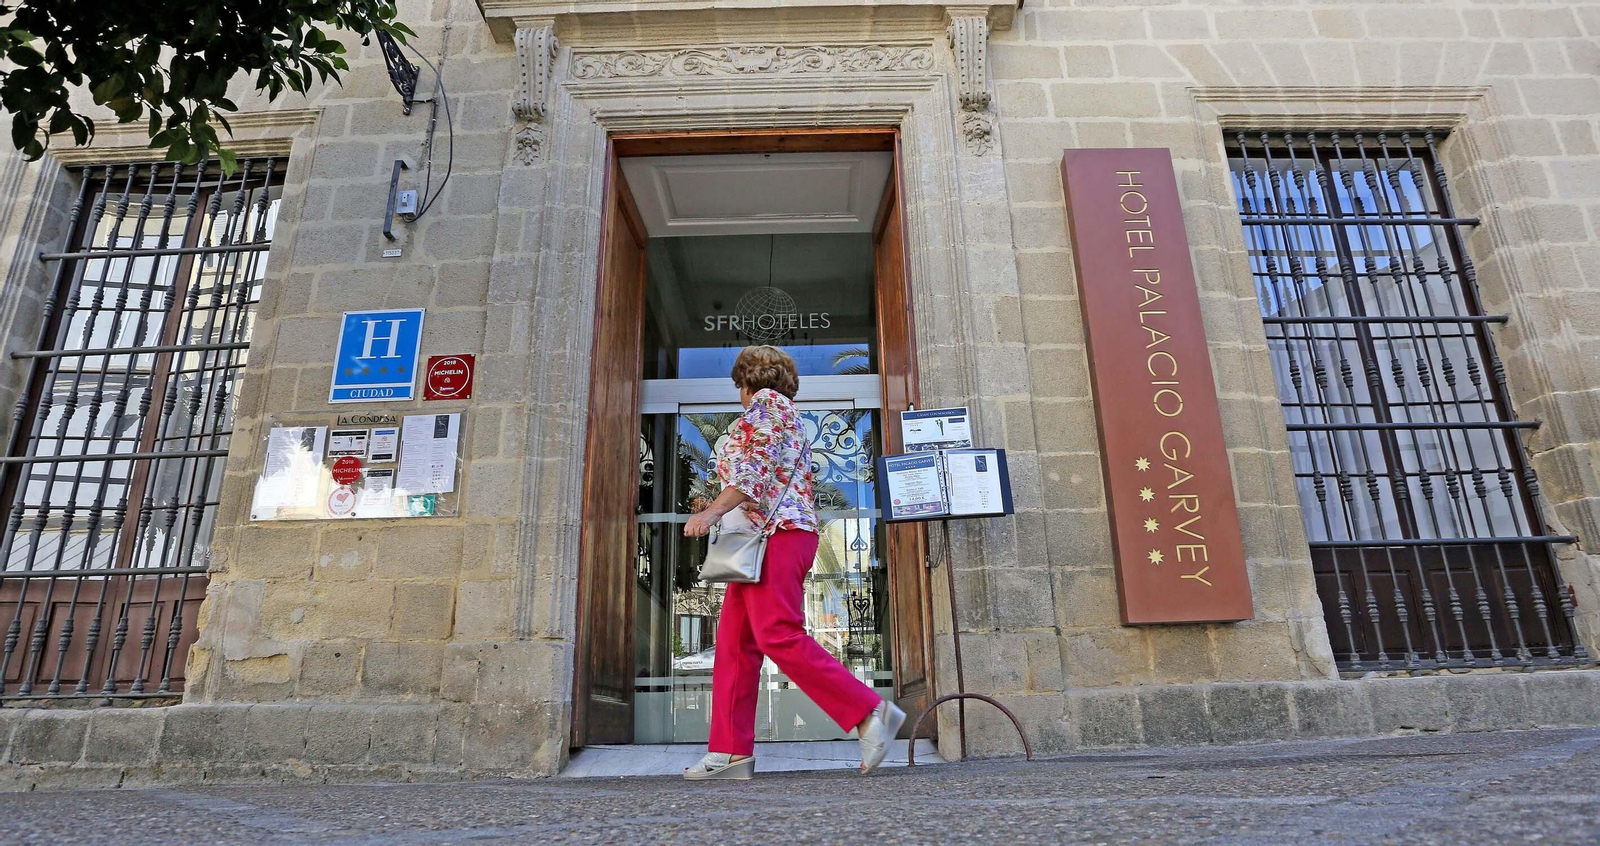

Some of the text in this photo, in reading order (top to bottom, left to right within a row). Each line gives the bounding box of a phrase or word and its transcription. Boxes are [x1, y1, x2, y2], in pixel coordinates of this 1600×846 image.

[355, 318, 407, 361] H
[349, 388, 395, 399] CIUDAD
[1115, 170, 1213, 587] HOTEL PALACIO GARVEY
